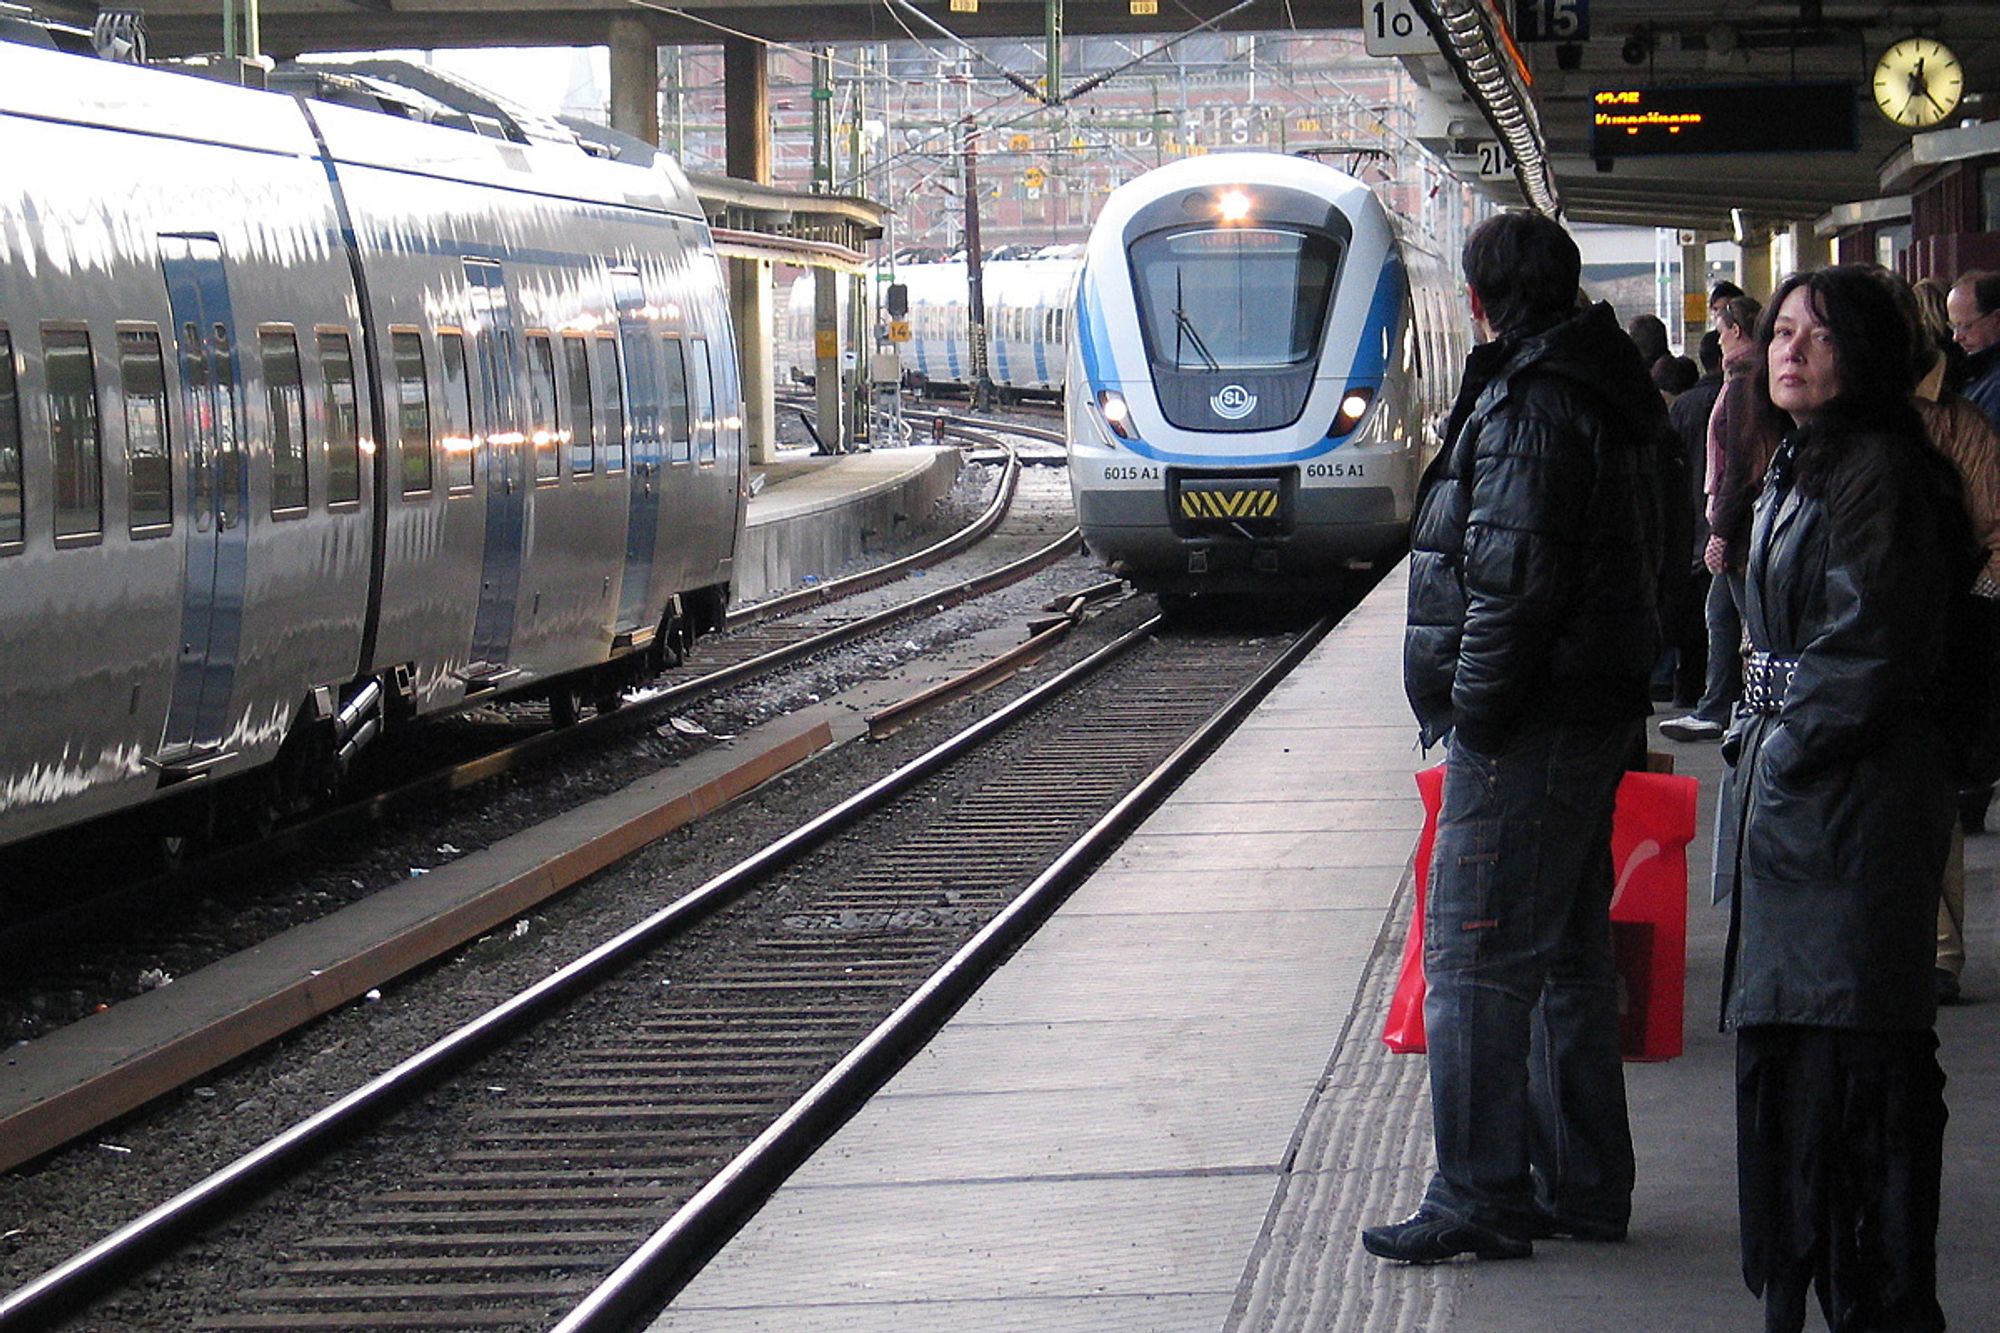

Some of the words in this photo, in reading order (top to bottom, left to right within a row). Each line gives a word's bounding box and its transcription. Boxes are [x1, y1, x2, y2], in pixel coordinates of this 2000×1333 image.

[1373, 1, 1431, 38] 10
[1529, 0, 1578, 36] 15
[1223, 391, 1243, 405] SL
[1104, 466, 1138, 480] 6015
[1141, 466, 1160, 480] A1
[1306, 464, 1344, 477] 6015
[1348, 464, 1364, 477] A1
